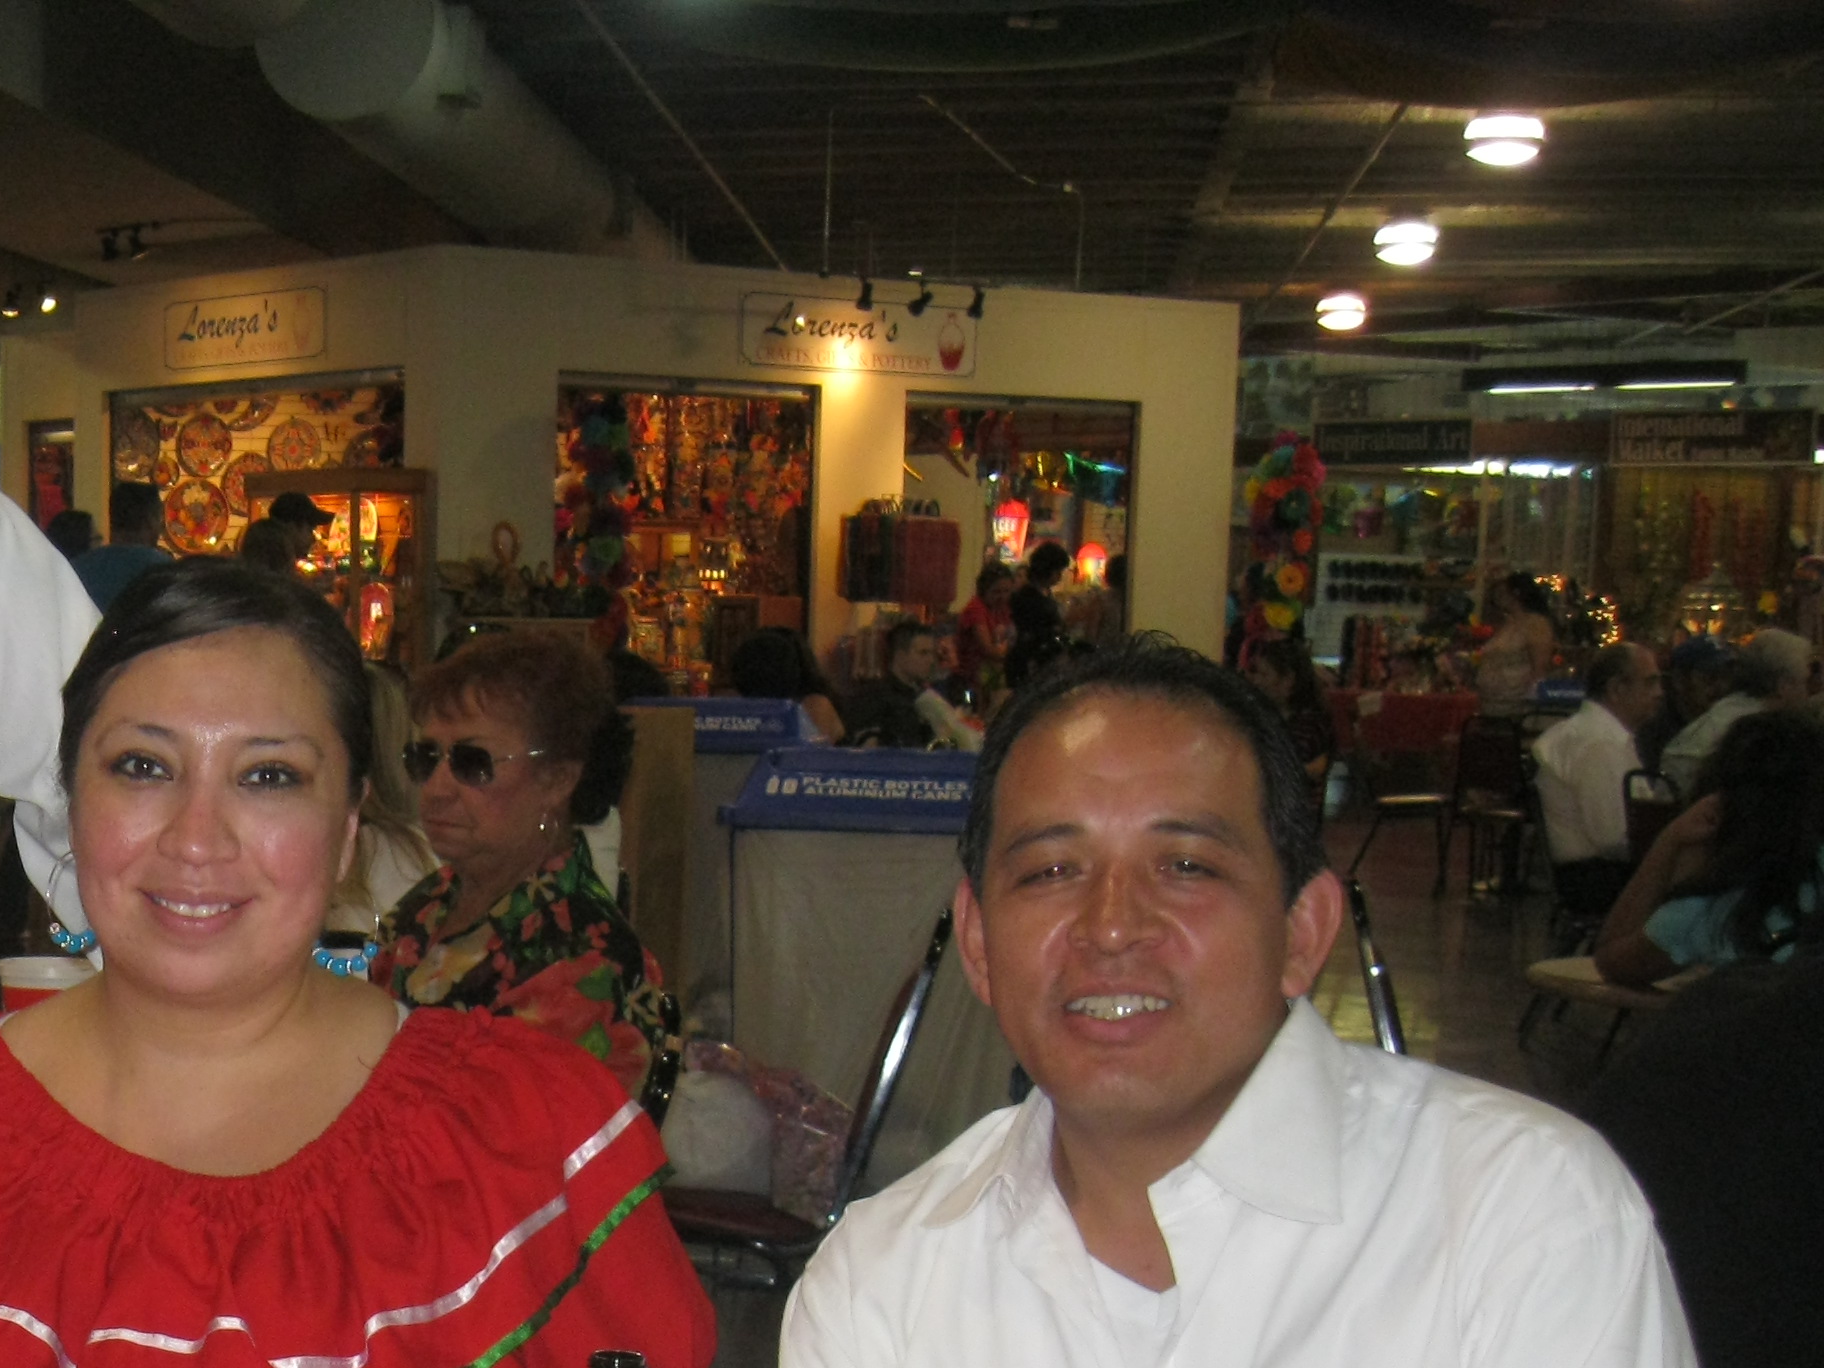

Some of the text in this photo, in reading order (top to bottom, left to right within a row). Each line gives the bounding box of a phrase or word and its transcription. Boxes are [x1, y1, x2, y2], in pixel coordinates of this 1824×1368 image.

[178, 298, 279, 348] Lorenza's
[764, 301, 898, 348] Lorenza's
[803, 776, 968, 792] PLASTIC BOTTLES
[804, 785, 963, 801] ALUMINUM CANS
